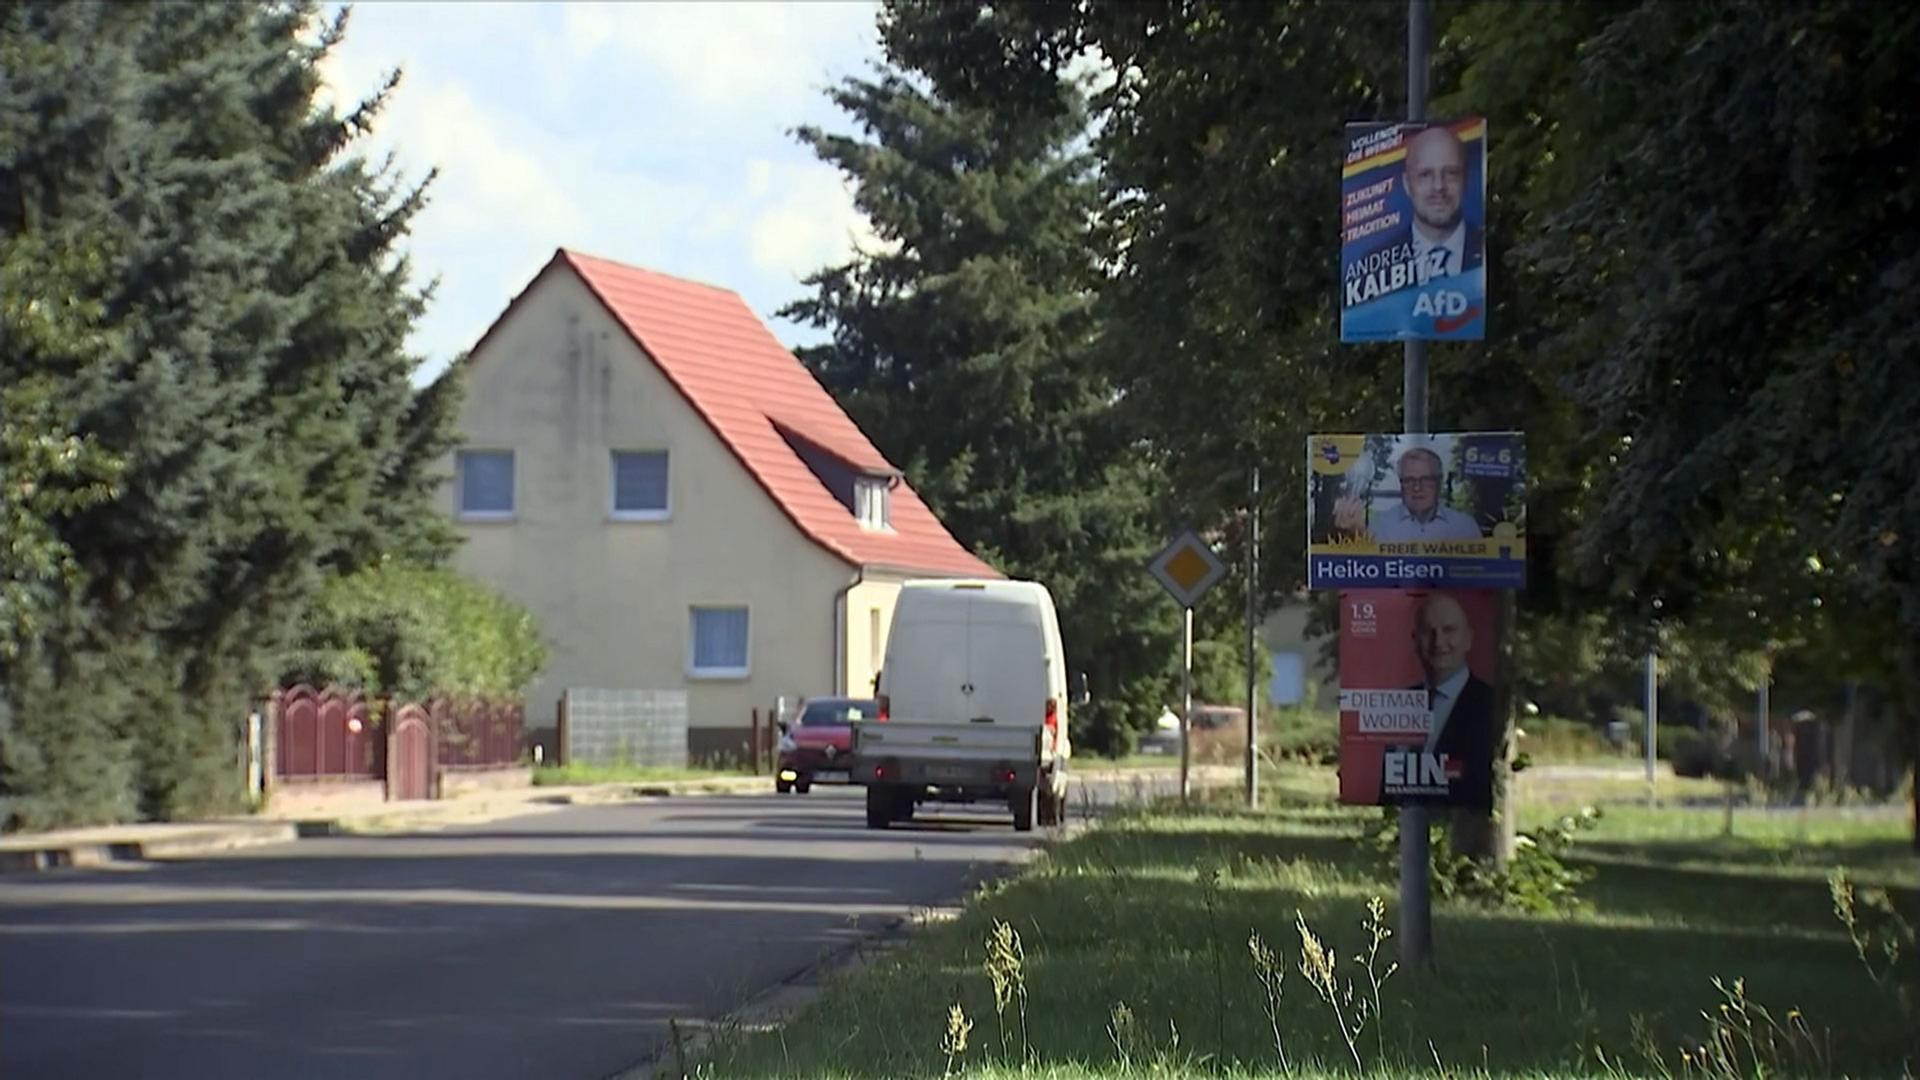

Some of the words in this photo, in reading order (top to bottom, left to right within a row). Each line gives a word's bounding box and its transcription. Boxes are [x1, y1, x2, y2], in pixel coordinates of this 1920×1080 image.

[1346, 177, 1394, 206] ZUKUNFT
[1346, 200, 1385, 224] HEIMAT
[1346, 211, 1400, 241] TRADITION
[1346, 250, 1445, 306] KALBITZ
[1413, 292, 1467, 317] AfD
[1465, 447, 1478, 462] 6
[1498, 448, 1511, 463] 6
[1379, 544, 1419, 555] FREIE
[1425, 542, 1487, 555] WÄHLER
[1317, 559, 1379, 578] Heiko
[1385, 561, 1444, 578] Eisen
[1351, 693, 1426, 709] DIETMAR
[1362, 713, 1432, 730] WOIDKE
[1385, 752, 1449, 785] EIN
